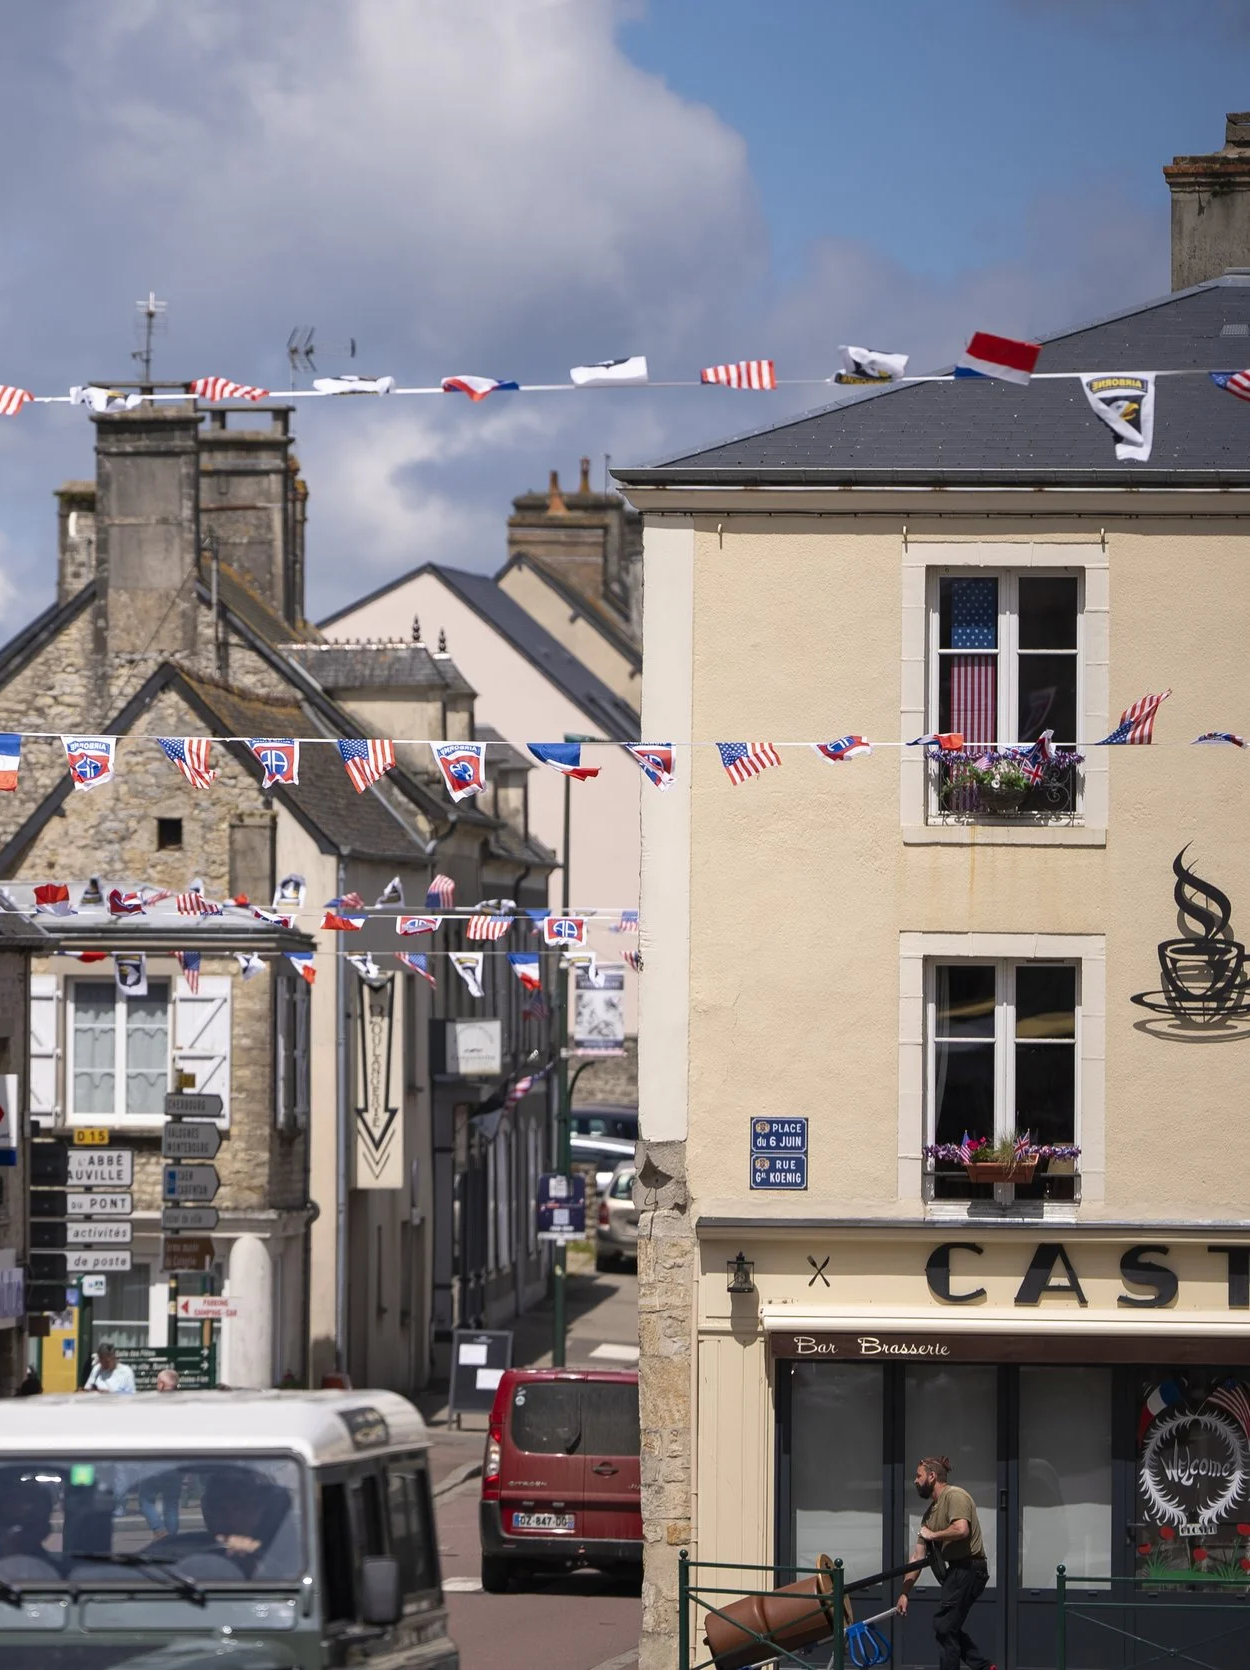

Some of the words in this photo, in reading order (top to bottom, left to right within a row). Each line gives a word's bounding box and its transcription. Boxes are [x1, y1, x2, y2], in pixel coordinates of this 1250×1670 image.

[772, 1123, 802, 1133] PLACE
[77, 1131, 85, 1142] D
[90, 1131, 106, 1142] 15
[756, 1136, 767, 1147] du
[769, 1136, 777, 1147] 6
[779, 1136, 802, 1148] JUIN
[776, 1160, 796, 1170] RUE
[769, 1172, 802, 1184] KOENIG
[90, 1198, 127, 1209] PONT
[74, 1256, 88, 1267] de
[93, 1256, 128, 1272] poste
[793, 1336, 839, 1355] Bar
[857, 1336, 951, 1357] Brasserie
